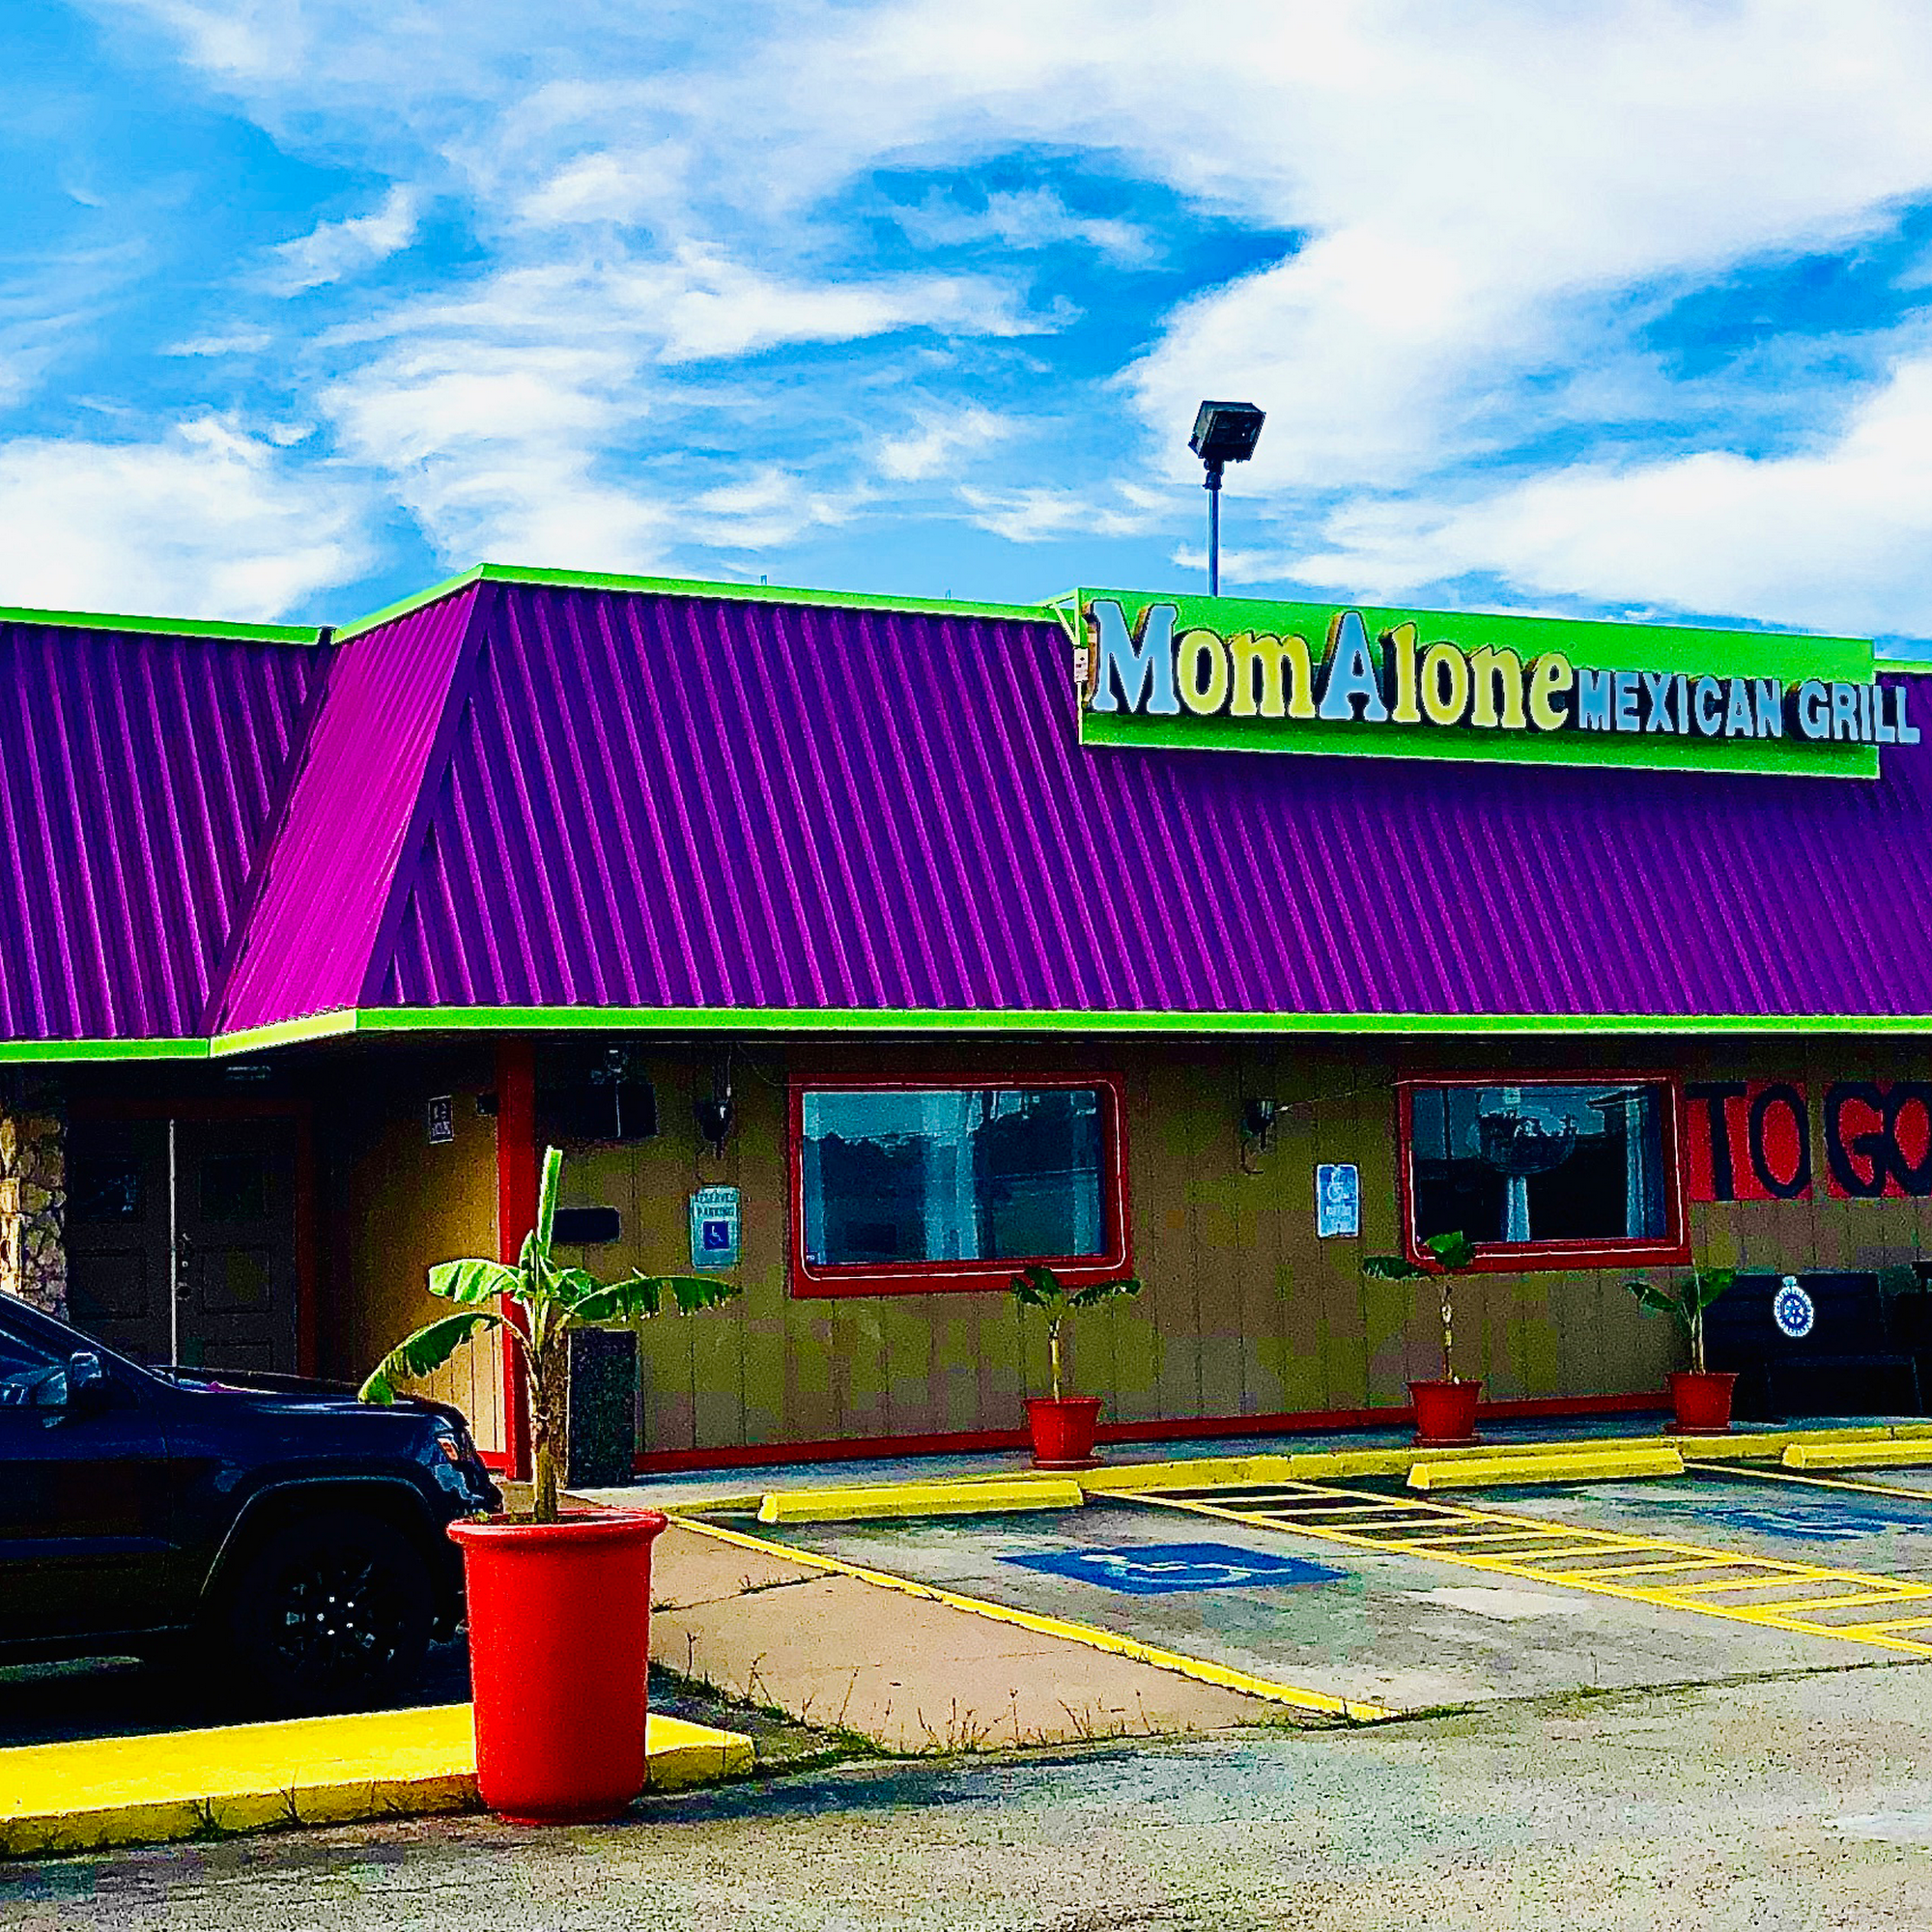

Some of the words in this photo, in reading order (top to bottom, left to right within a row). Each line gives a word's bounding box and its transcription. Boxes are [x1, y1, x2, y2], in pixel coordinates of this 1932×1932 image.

[1091, 599, 1317, 719] Mom
[1318, 611, 1574, 731] Alone
[1577, 668, 1782, 738] MEXICAN
[1799, 679, 1922, 744] GRILL
[1684, 1081, 1811, 1201] TO
[1824, 1080, 1932, 1198] GO
